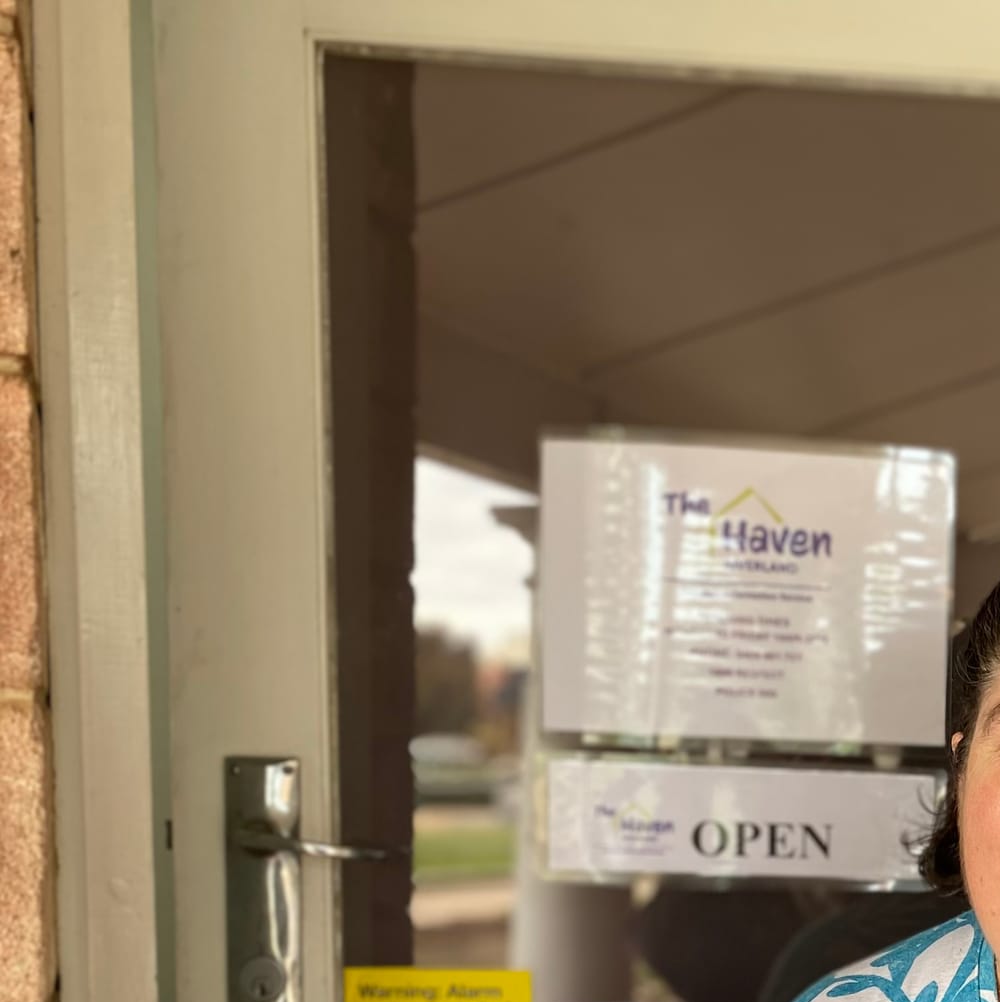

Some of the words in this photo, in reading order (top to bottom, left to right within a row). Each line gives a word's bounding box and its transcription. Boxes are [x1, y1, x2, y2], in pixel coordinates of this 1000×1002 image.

[664, 491, 711, 517] The
[721, 519, 832, 557] Haven
[691, 819, 833, 860] OPEN
[446, 984, 503, 999] Alarm
